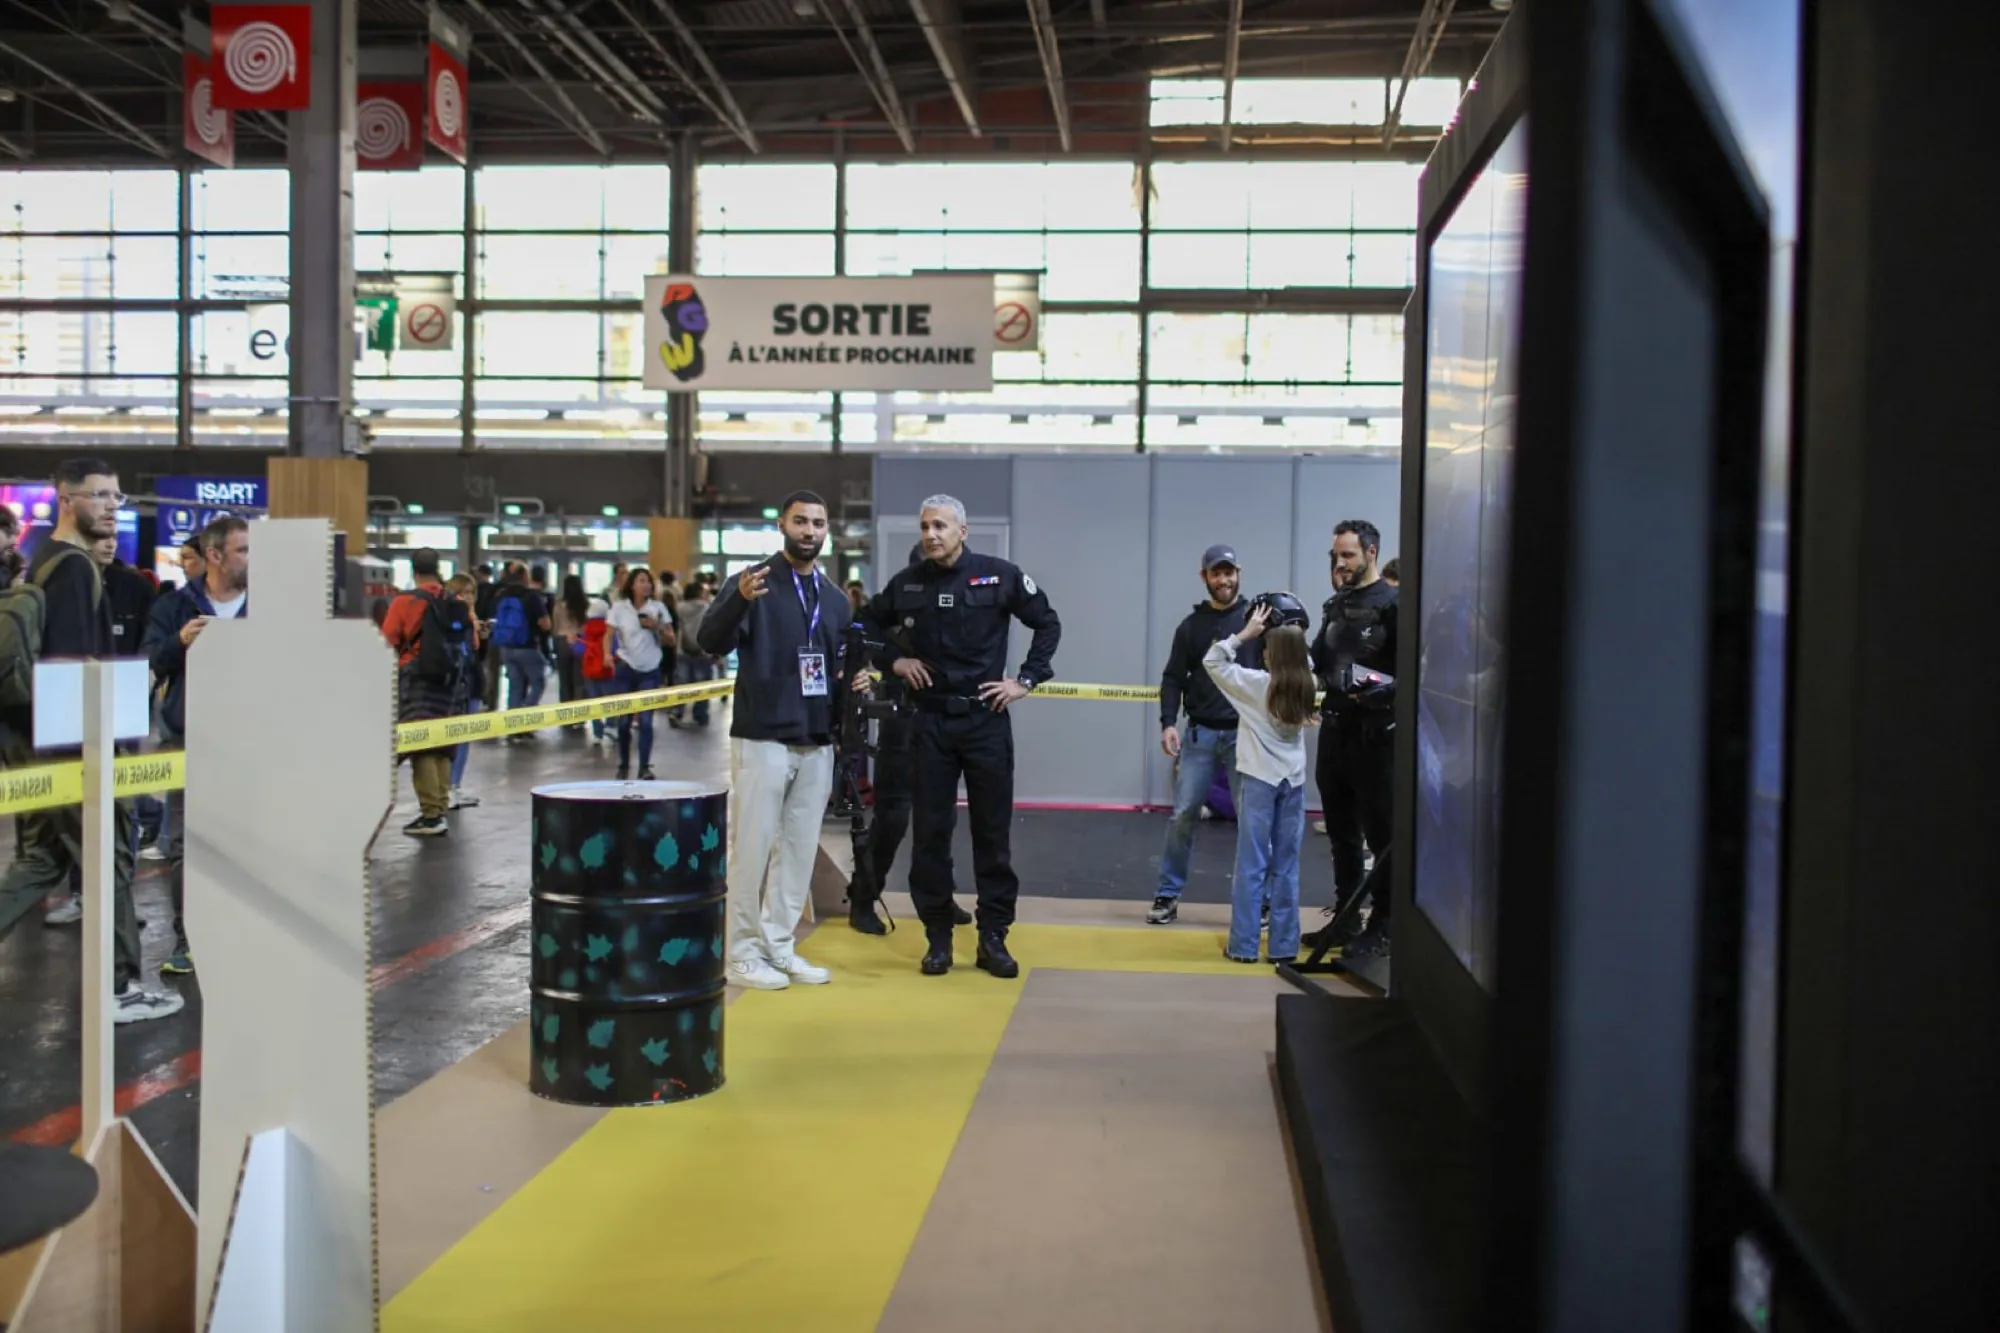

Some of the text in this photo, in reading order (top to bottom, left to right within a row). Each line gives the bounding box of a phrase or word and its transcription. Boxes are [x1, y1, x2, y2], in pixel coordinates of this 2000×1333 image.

[773, 303, 932, 336] SORTIE
[729, 340, 743, 363] À
[846, 346, 976, 365] PROCHAINE
